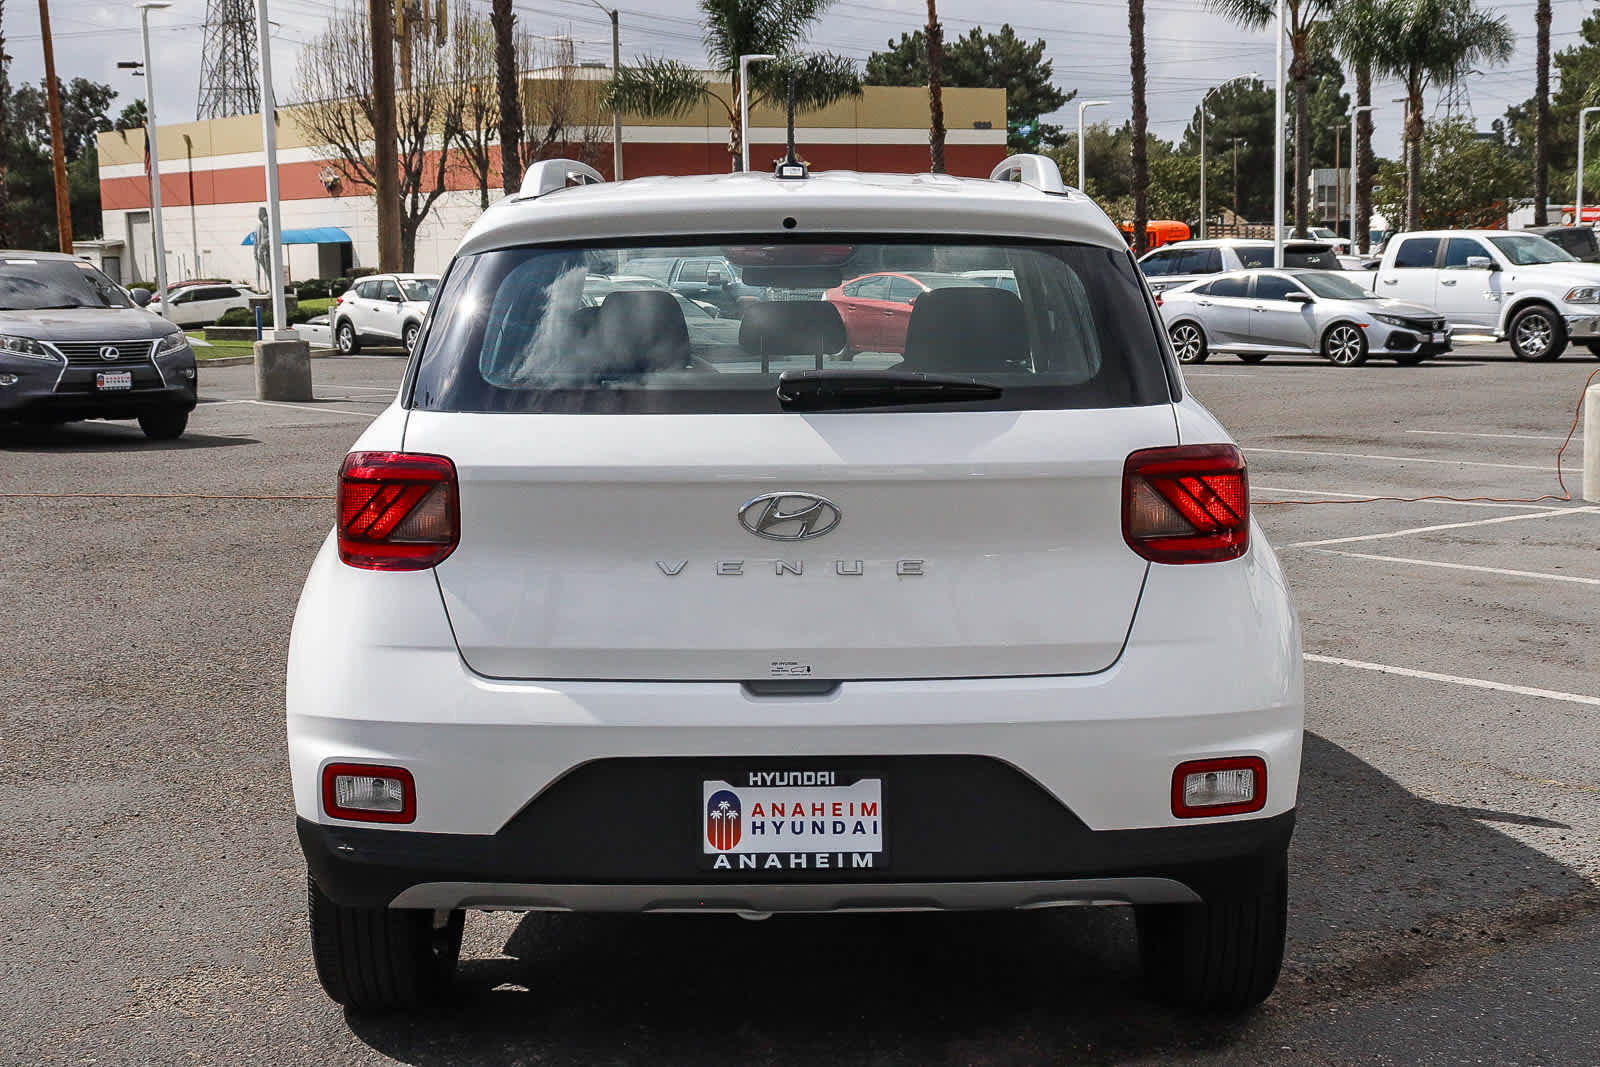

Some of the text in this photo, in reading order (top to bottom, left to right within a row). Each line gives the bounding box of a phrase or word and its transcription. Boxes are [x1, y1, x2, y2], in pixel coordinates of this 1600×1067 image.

[656, 559, 925, 577] VENUE
[749, 771, 835, 786] HYUNDAI
[751, 801, 878, 818] ANAHEIM
[751, 820, 878, 836] HYUNDAI
[713, 854, 873, 870] ANAHEIM
